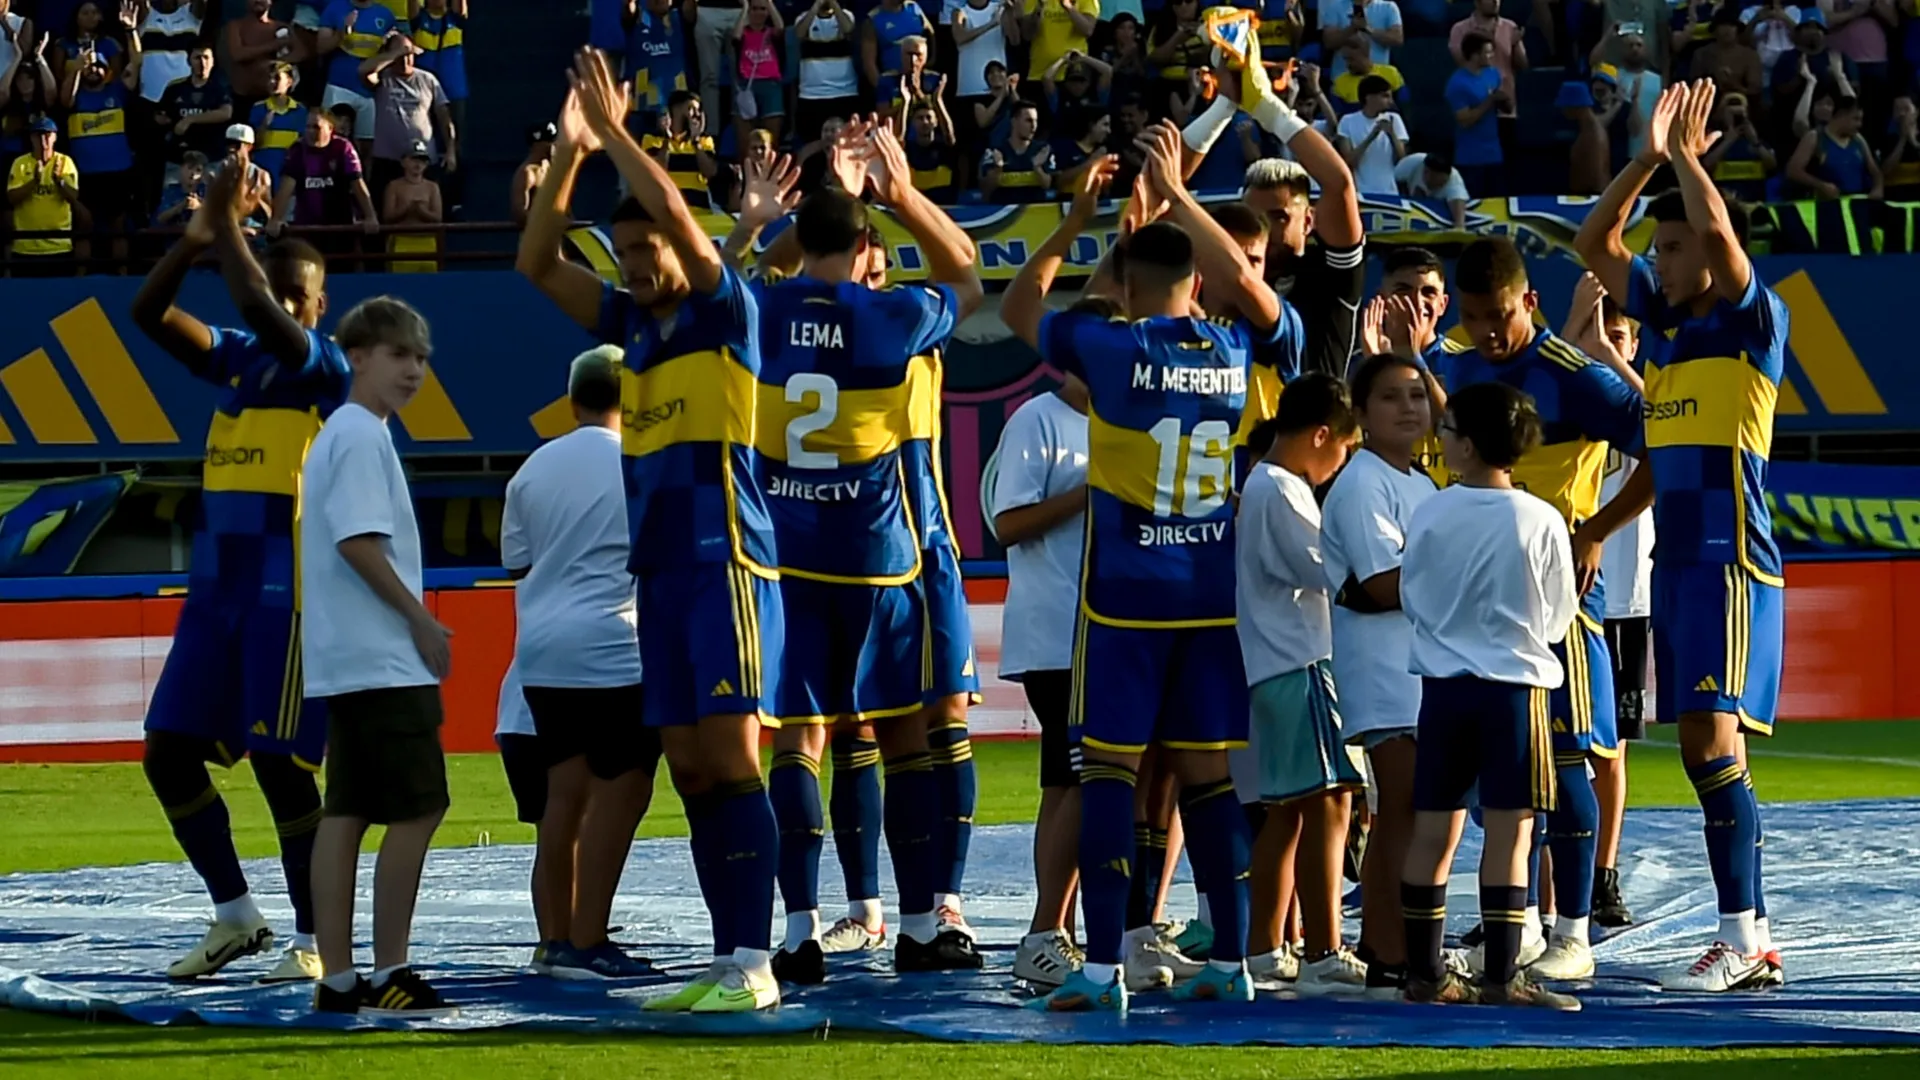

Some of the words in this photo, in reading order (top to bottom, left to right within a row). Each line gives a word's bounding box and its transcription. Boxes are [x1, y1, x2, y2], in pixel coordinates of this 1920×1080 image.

[790, 320, 845, 349] LEMA
[1131, 361, 1155, 390] M.
[784, 372, 839, 470] 2
[1147, 416, 1231, 519] 16
[766, 474, 861, 502] DIRECTV
[1138, 520, 1226, 547] DIRECTV
